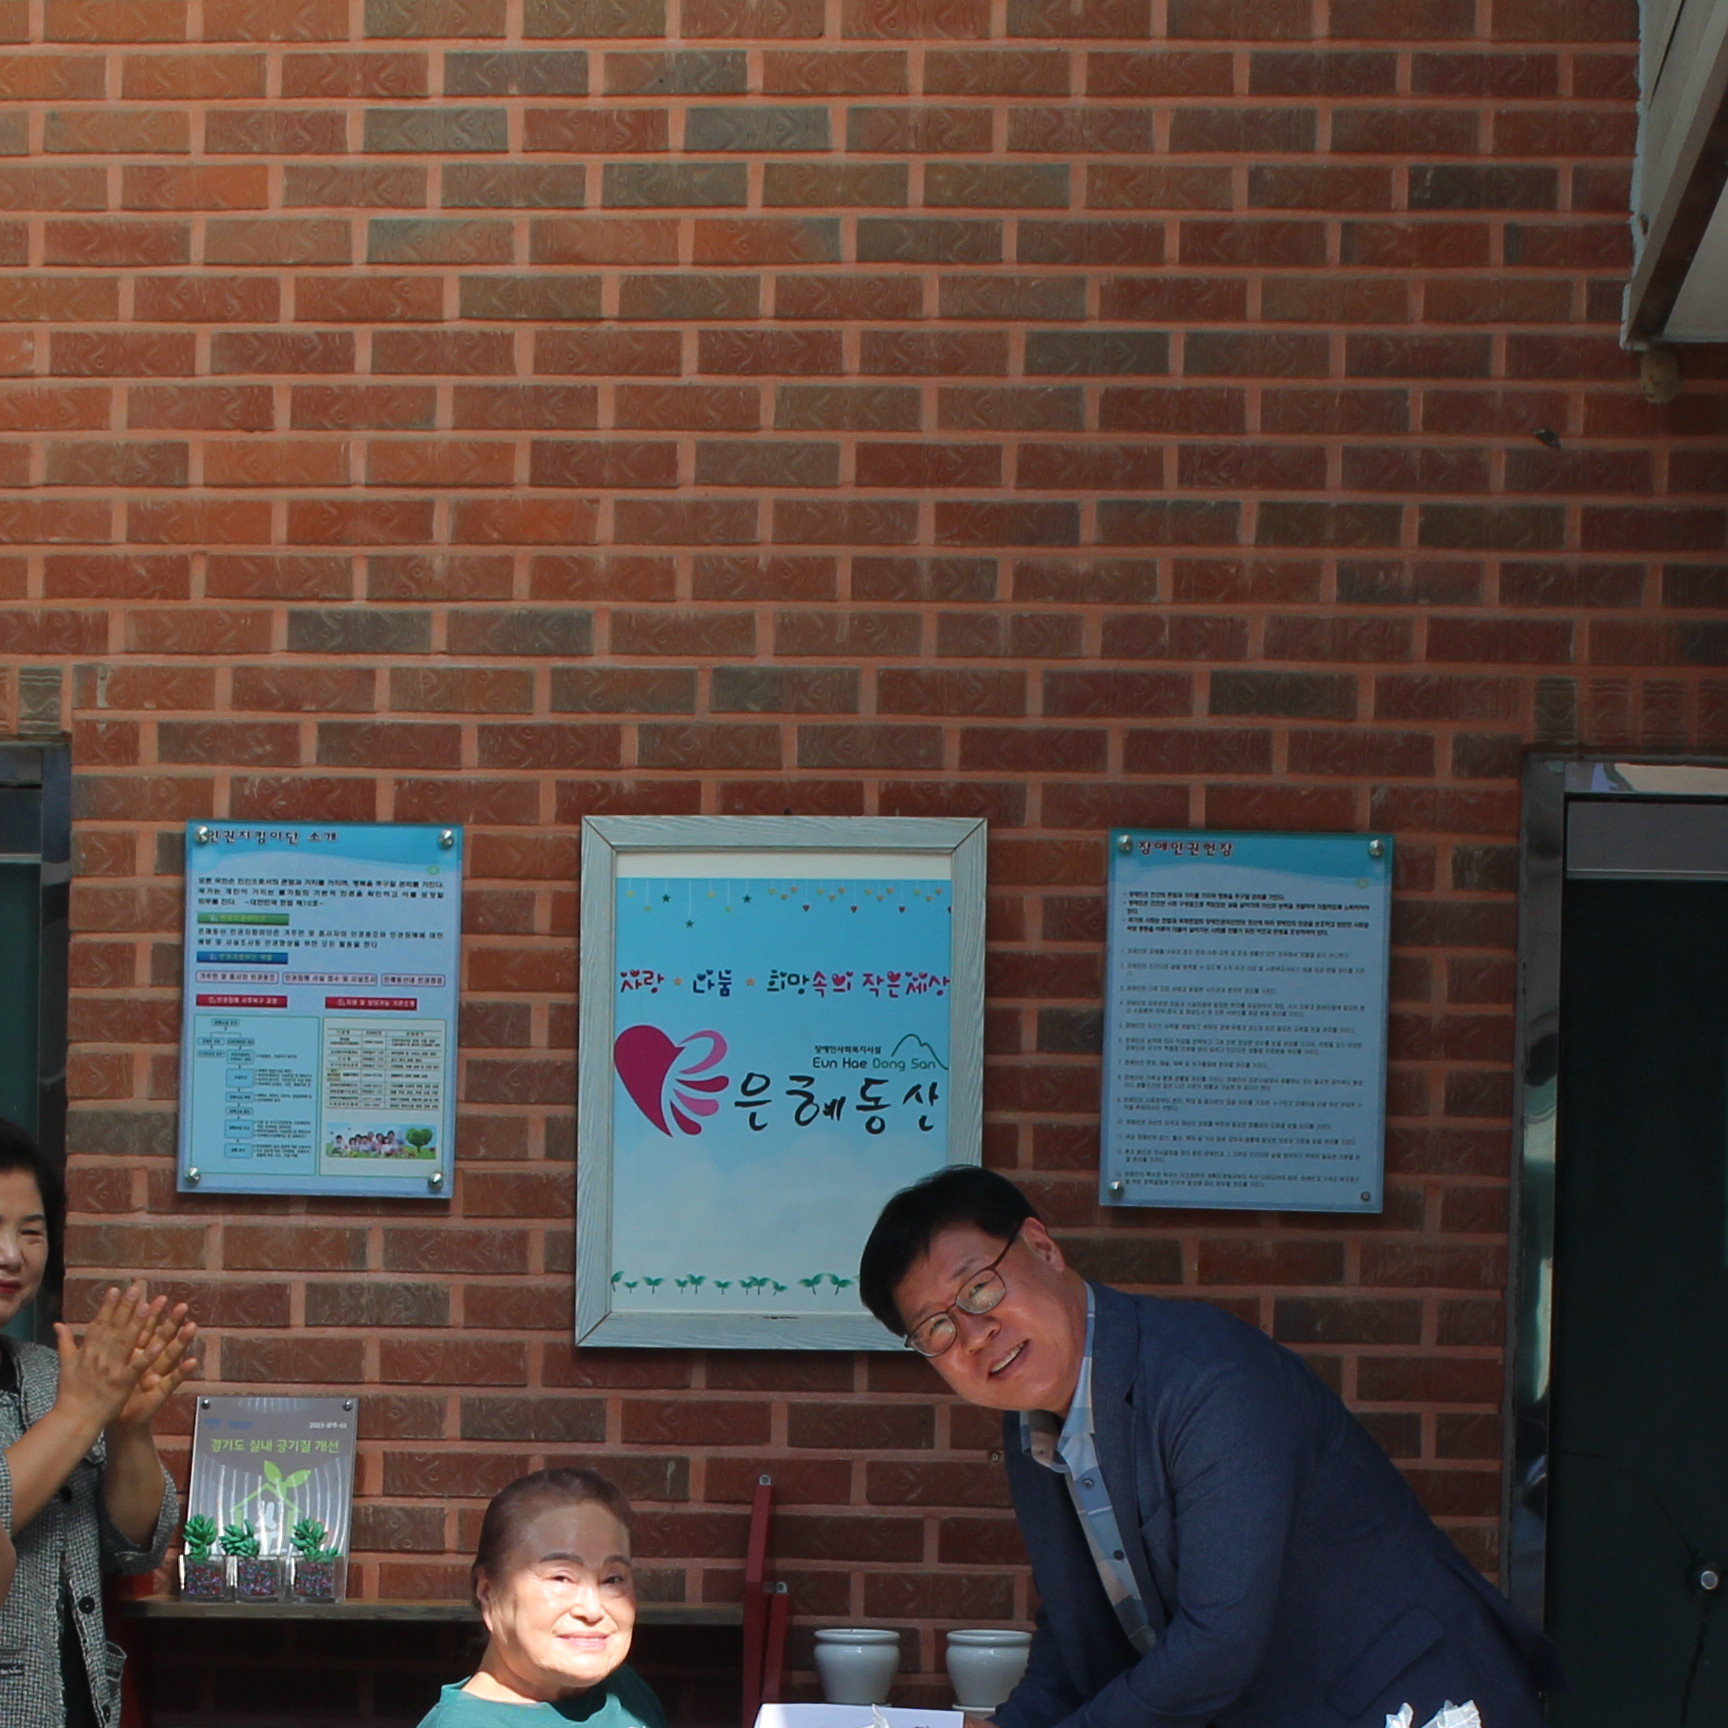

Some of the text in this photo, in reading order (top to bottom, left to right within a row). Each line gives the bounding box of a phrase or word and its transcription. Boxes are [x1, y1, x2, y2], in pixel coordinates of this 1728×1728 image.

[208, 830, 338, 845] 인권지킴이단 소개
[1138, 840, 1233, 857] 장애인권헌장
[620, 968, 951, 998] 사랑 나눔 희망속의 작은세상
[812, 1056, 936, 1072] Eun Hae Dong San
[734, 1072, 940, 1135] 은혜동산
[210, 1438, 245, 1453] 경기도
[249, 1438, 273, 1453] 실내
[315, 1438, 340, 1453] 개선
